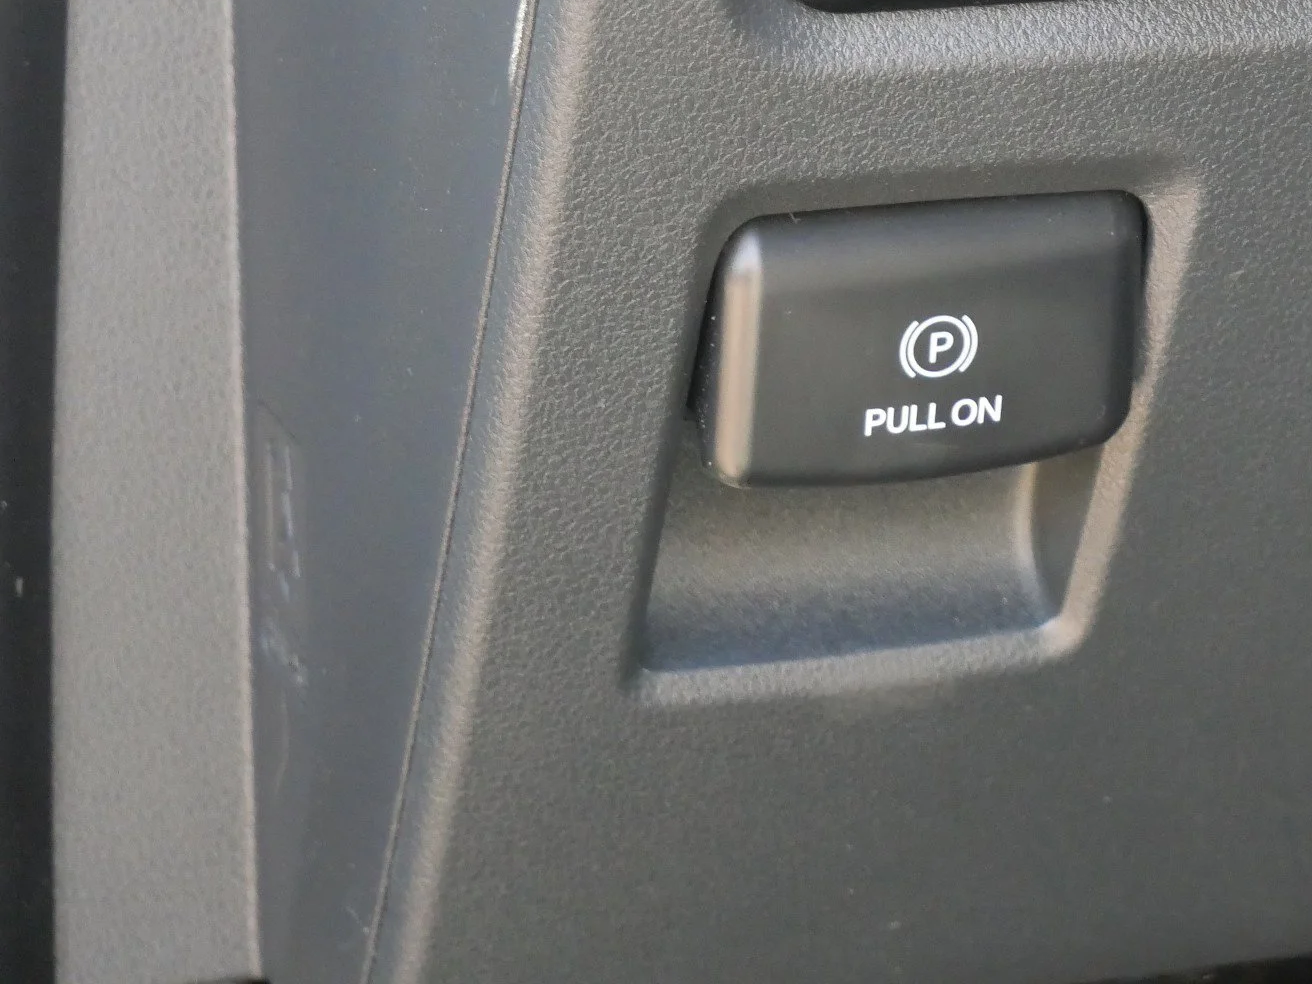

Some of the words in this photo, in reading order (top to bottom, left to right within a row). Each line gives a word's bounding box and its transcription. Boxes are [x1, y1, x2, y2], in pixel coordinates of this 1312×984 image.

[928, 331, 954, 364] P
[864, 402, 946, 437] PULL
[951, 394, 1003, 427] ON
